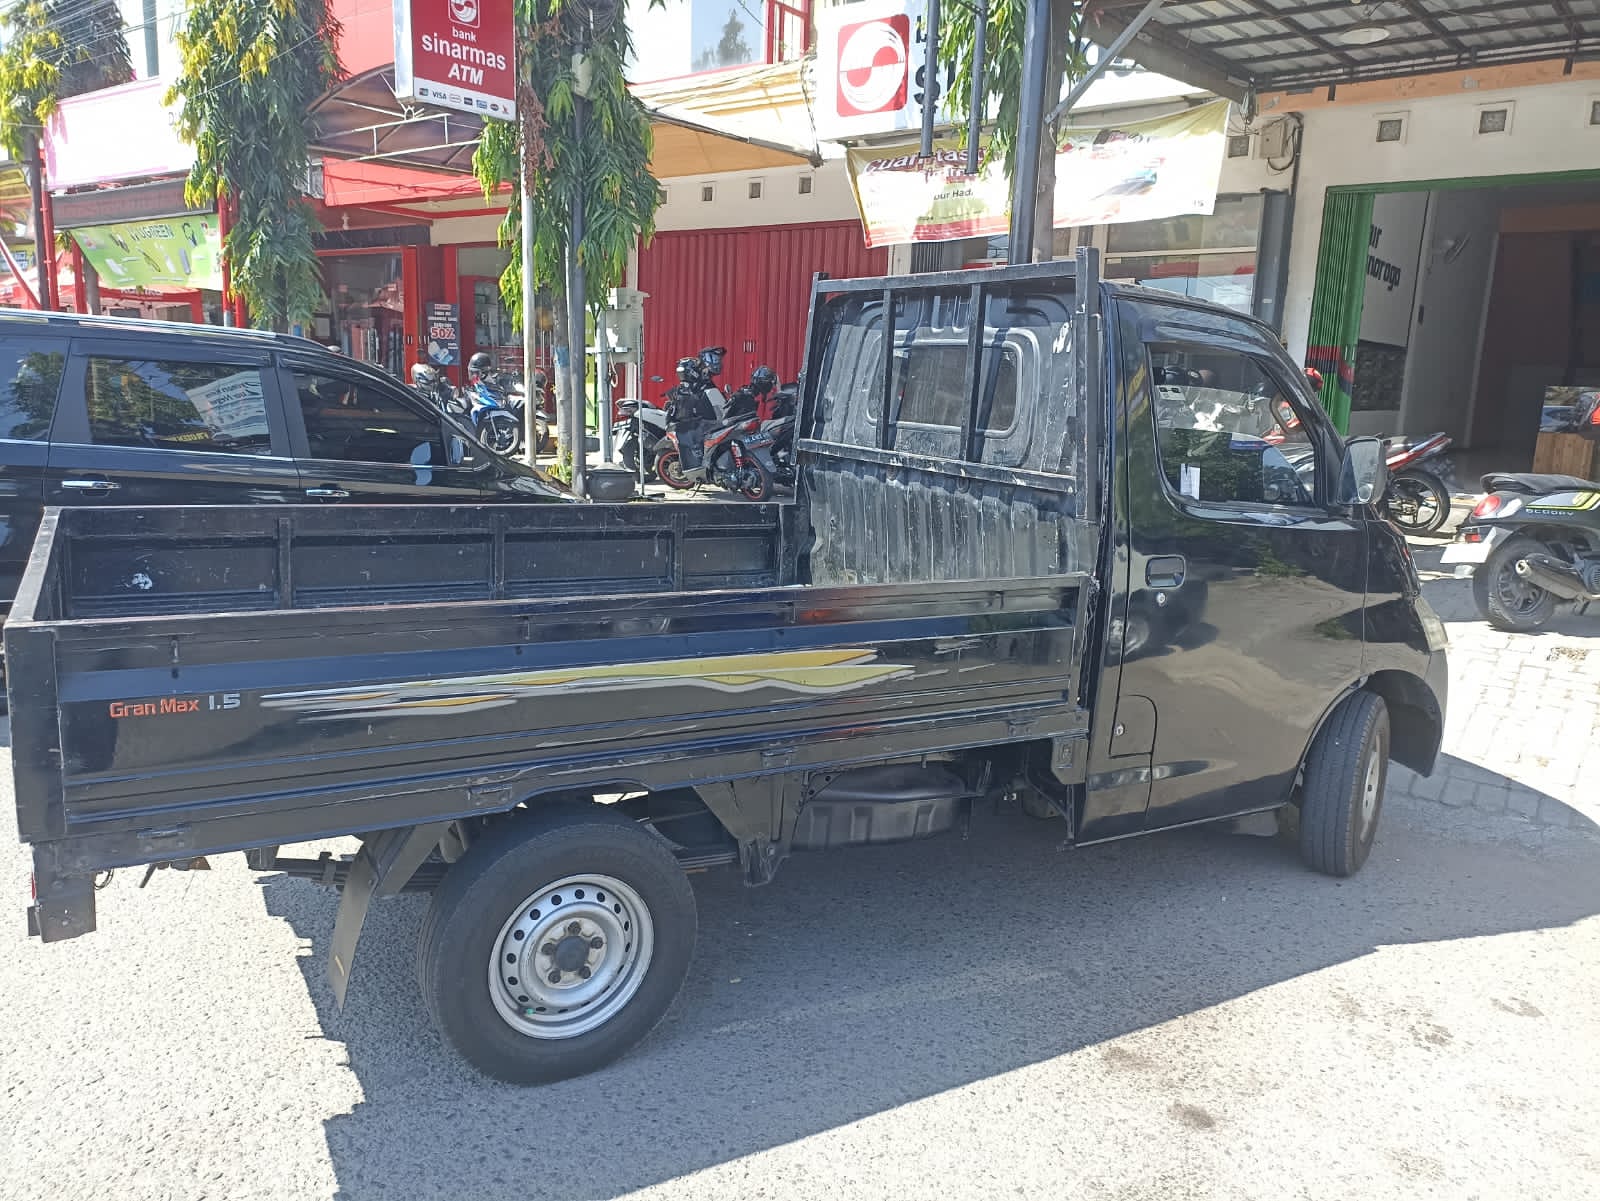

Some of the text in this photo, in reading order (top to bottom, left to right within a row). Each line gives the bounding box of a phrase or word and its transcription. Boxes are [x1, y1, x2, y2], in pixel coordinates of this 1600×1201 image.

[452, 27, 477, 42] bank
[421, 33, 506, 71] sinarmas
[448, 63, 484, 86] ATM
[432, 91, 447, 101] VISA
[430, 327, 456, 340] 50%
[109, 692, 241, 718] Gran Max 1.5
